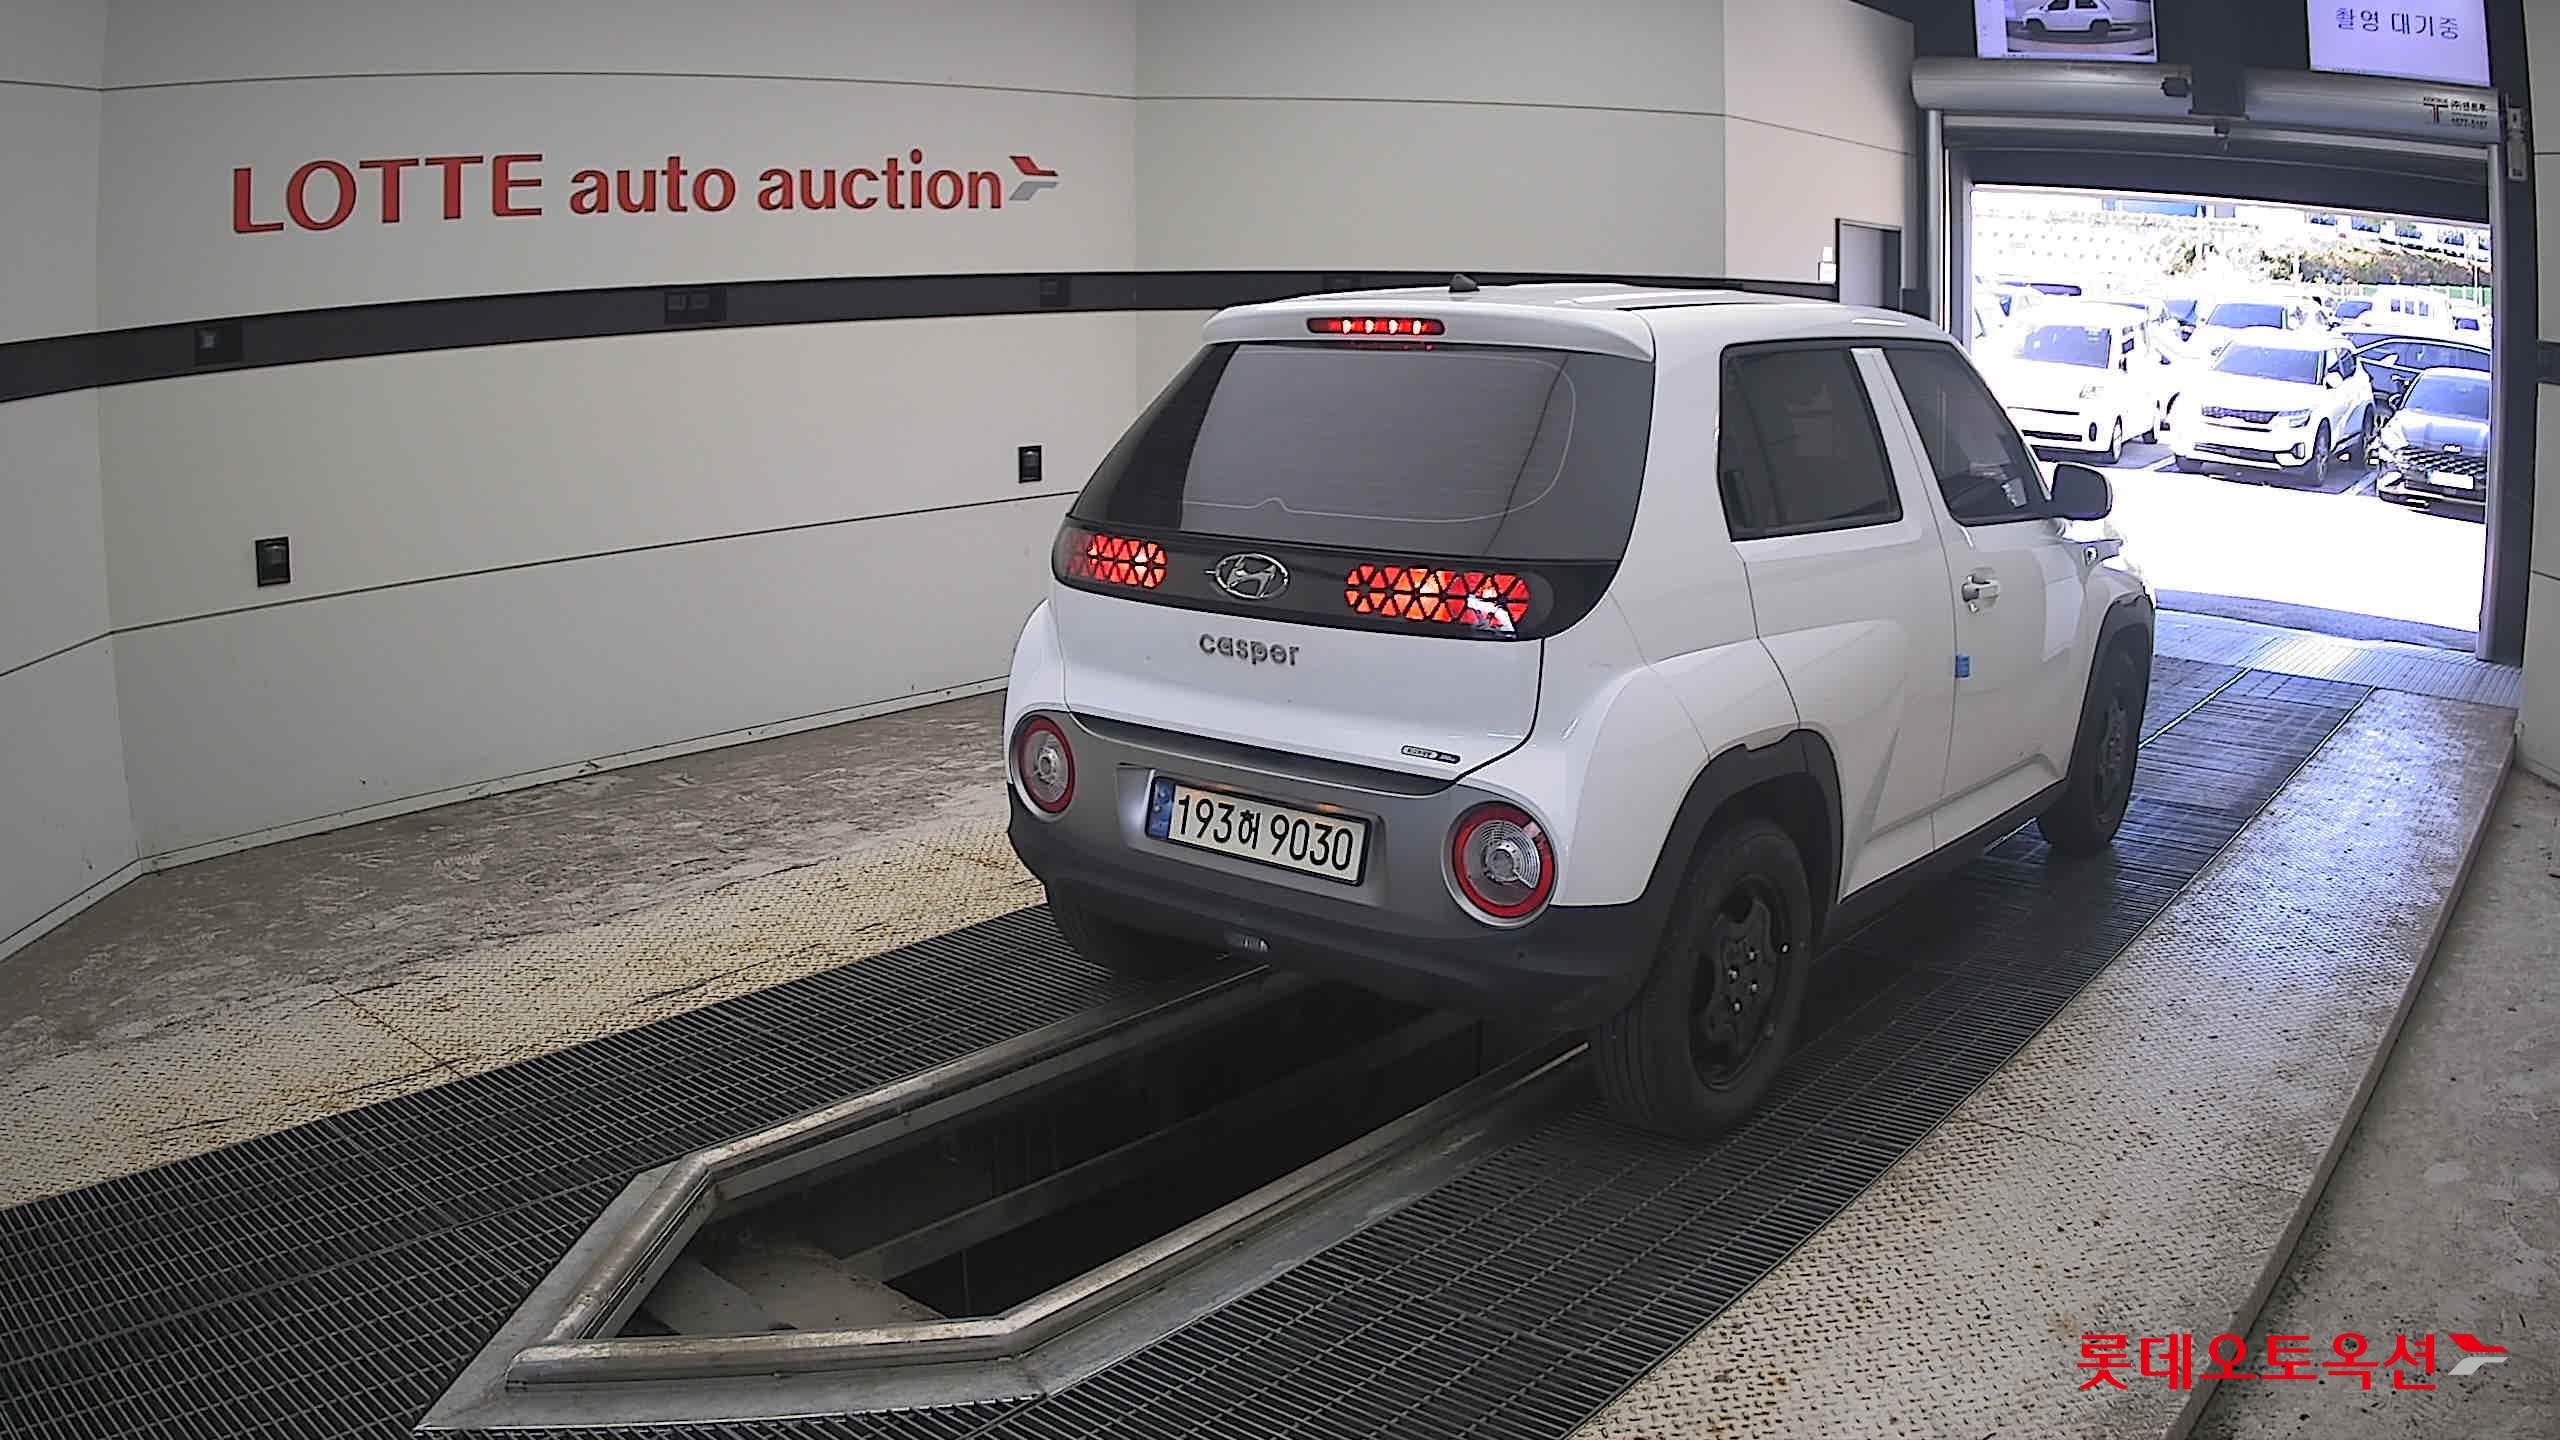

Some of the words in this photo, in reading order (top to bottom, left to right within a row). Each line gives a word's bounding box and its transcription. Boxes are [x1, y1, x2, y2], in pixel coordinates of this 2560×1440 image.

[2336, 8, 2379, 32] 촬영
[2391, 13, 2458, 39] 대기중
[233, 154, 543, 234] LOTTE
[569, 155, 736, 215] auto
[757, 148, 1002, 211] auction
[1199, 633, 1300, 666] casper
[1178, 794, 1261, 850] 193허
[1270, 814, 1354, 871] 9030
